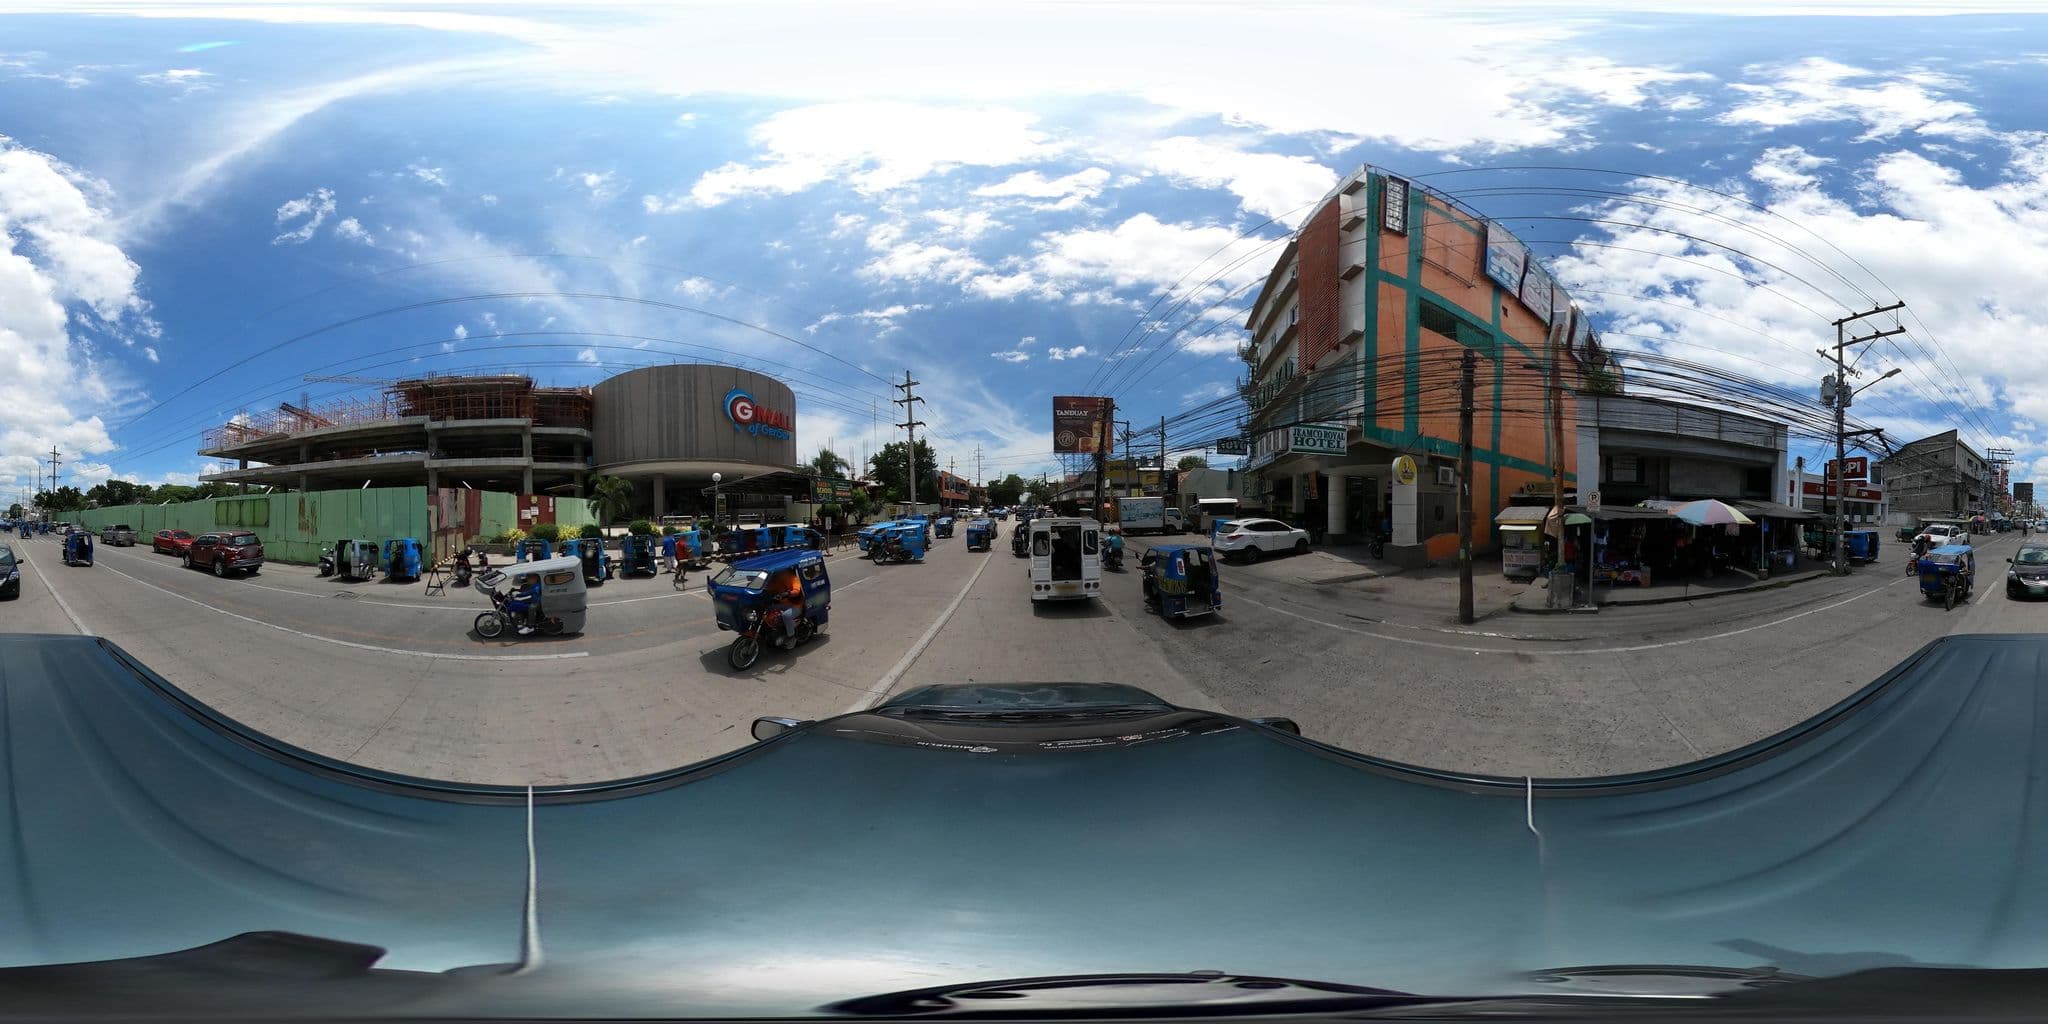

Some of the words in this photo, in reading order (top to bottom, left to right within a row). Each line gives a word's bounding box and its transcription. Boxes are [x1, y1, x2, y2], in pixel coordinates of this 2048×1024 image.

[755, 405, 794, 432] MALL
[1056, 409, 1089, 417] TANDUAY
[1323, 430, 1345, 441] ROYAL
[1293, 436, 1345, 449] HOTEL
